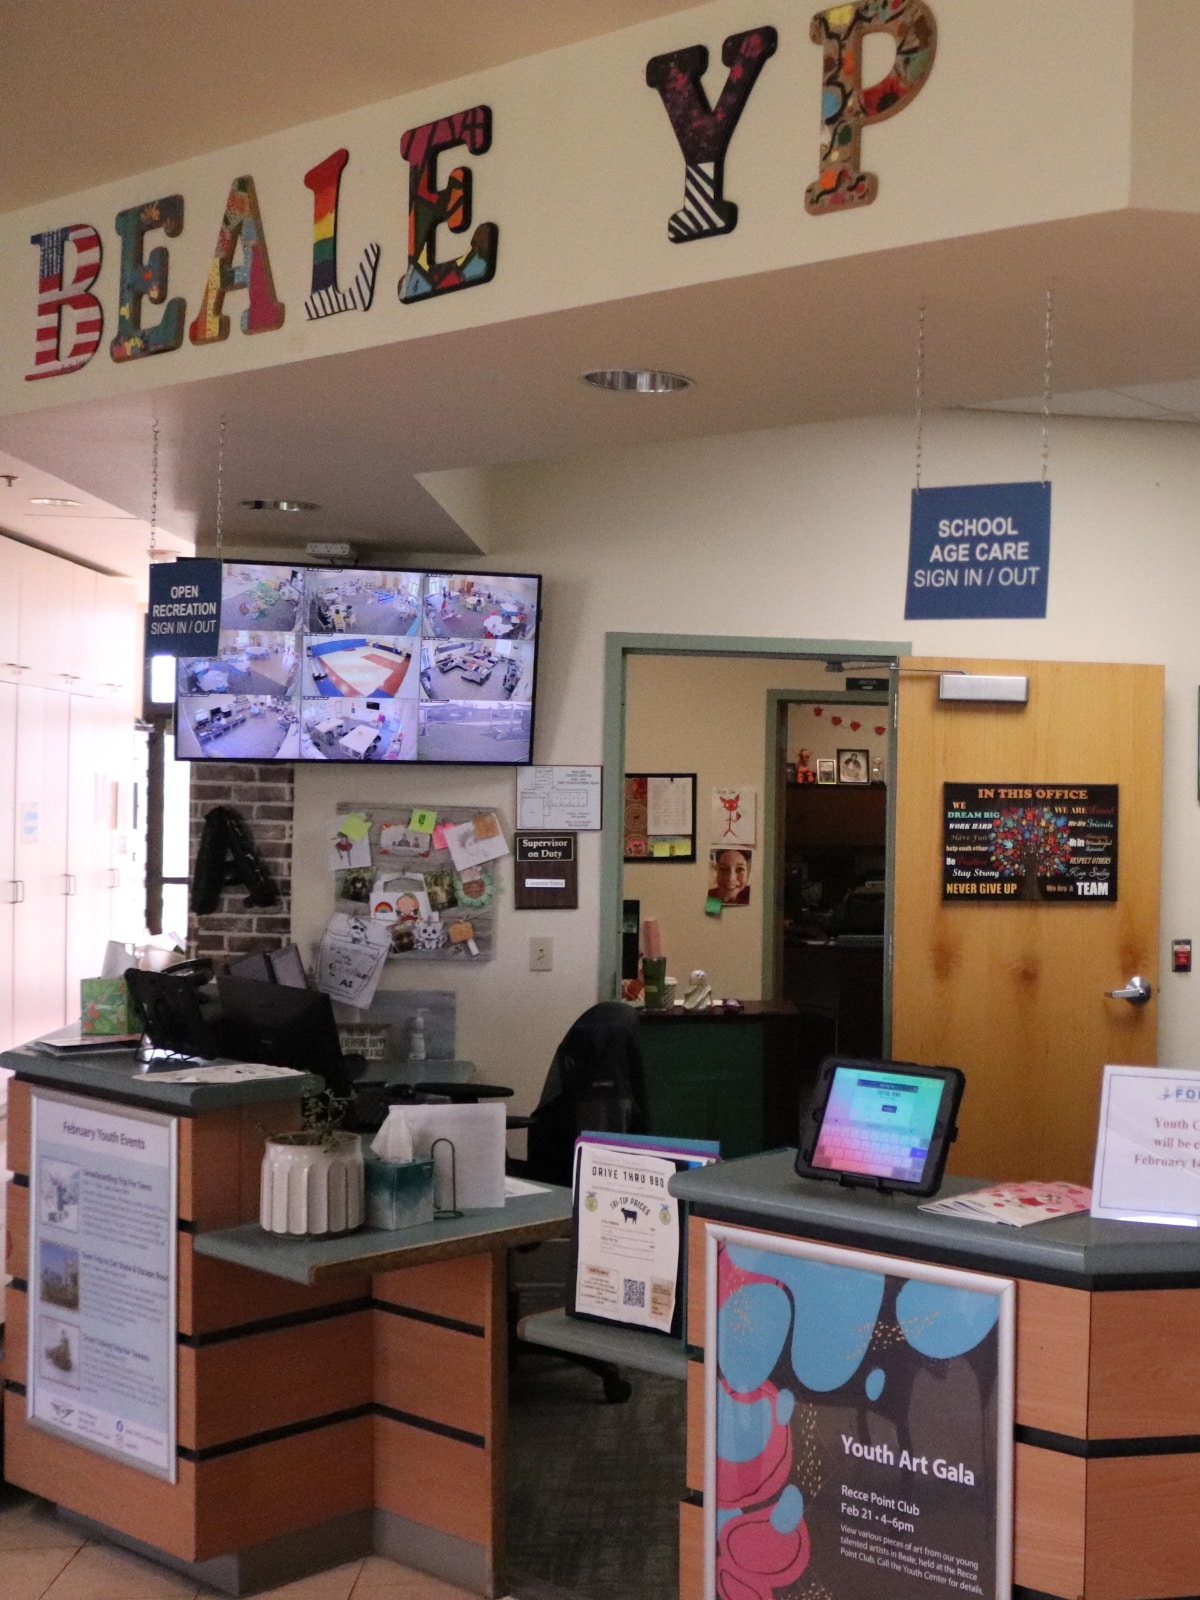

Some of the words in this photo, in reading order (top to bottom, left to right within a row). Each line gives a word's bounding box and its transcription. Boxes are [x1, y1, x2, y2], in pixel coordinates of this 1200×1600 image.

[25, 104, 498, 381] BEALE
[645, 0, 937, 243] YP
[938, 517, 1019, 538] SCHOOL
[929, 543, 970, 563] AGE
[975, 541, 1030, 562] CARE
[913, 568, 959, 588] SIGN
[964, 568, 983, 586] IN
[998, 567, 1041, 586] OUT
[170, 585, 199, 599] OPEN
[152, 602, 217, 617] RECREATION
[150, 622, 174, 635] SIGN
[176, 621, 187, 634] IN
[194, 620, 217, 634] OUT
[978, 789, 995, 799] IN
[999, 789, 1032, 799] THIS
[1035, 789, 1088, 800] OFFICE
[952, 802, 967, 810] WE
[1054, 806, 1069, 814] WE
[1071, 806, 1087, 814] ARE
[947, 811, 982, 819] DREAM
[983, 811, 1000, 819] BIG
[1086, 819, 1114, 828] Friends
[522, 839, 568, 850] Supervisor
[541, 850, 562, 860] Duty
[946, 857, 956, 866] Be
[952, 868, 972, 878] Stay
[973, 868, 1000, 879] Strong
[946, 883, 977, 894] NEVER
[980, 883, 1002, 894] GIVE
[1003, 883, 1017, 894] UP
[1076, 882, 1109, 896] TEAM
[1154, 1117, 1189, 1131] Youth
[62, 1121, 96, 1142] February
[97, 1128, 120, 1144] Youth
[120, 1133, 146, 1150] Events
[1153, 1137, 1174, 1149] will
[1177, 1138, 1191, 1150] be
[1134, 1154, 1188, 1170] February
[592, 1166, 618, 1180] DRIVE
[623, 1171, 646, 1184] THRU
[649, 1175, 665, 1188] BBQ
[609, 1196, 629, 1210] TRI-TIP
[630, 1198, 651, 1217] PRICES
[841, 1434, 894, 1466] Youth
[899, 1450, 928, 1475] Art
[933, 1458, 975, 1486] Gala
[841, 1484, 869, 1501] Recce
[870, 1492, 896, 1510] Point
[897, 1500, 920, 1516] Club
[841, 1502, 859, 1517] Feb
[861, 1508, 873, 1520] 21
[840, 1524, 857, 1535] View
[858, 1528, 882, 1542] various
[883, 1535, 904, 1549] pieces
[904, 1542, 912, 1550] of
[913, 1544, 923, 1554] art
[925, 1547, 942, 1559] from
[942, 1553, 955, 1562] our
[955, 1556, 979, 1571] young
[840, 1536, 868, 1550] talented
[869, 1543, 889, 1556] artists
[890, 1548, 897, 1559] in
[918, 1557, 935, 1569] held
[936, 1563, 944, 1572] at
[944, 1564, 956, 1575] the
[957, 1568, 978, 1582] Recce
[840, 1547, 857, 1559] Point
[877, 1557, 890, 1568] Call
[890, 1561, 902, 1571] the
[903, 1566, 923, 1578] Youth
[924, 1572, 947, 1585] Center
[948, 1577, 958, 1587] for
